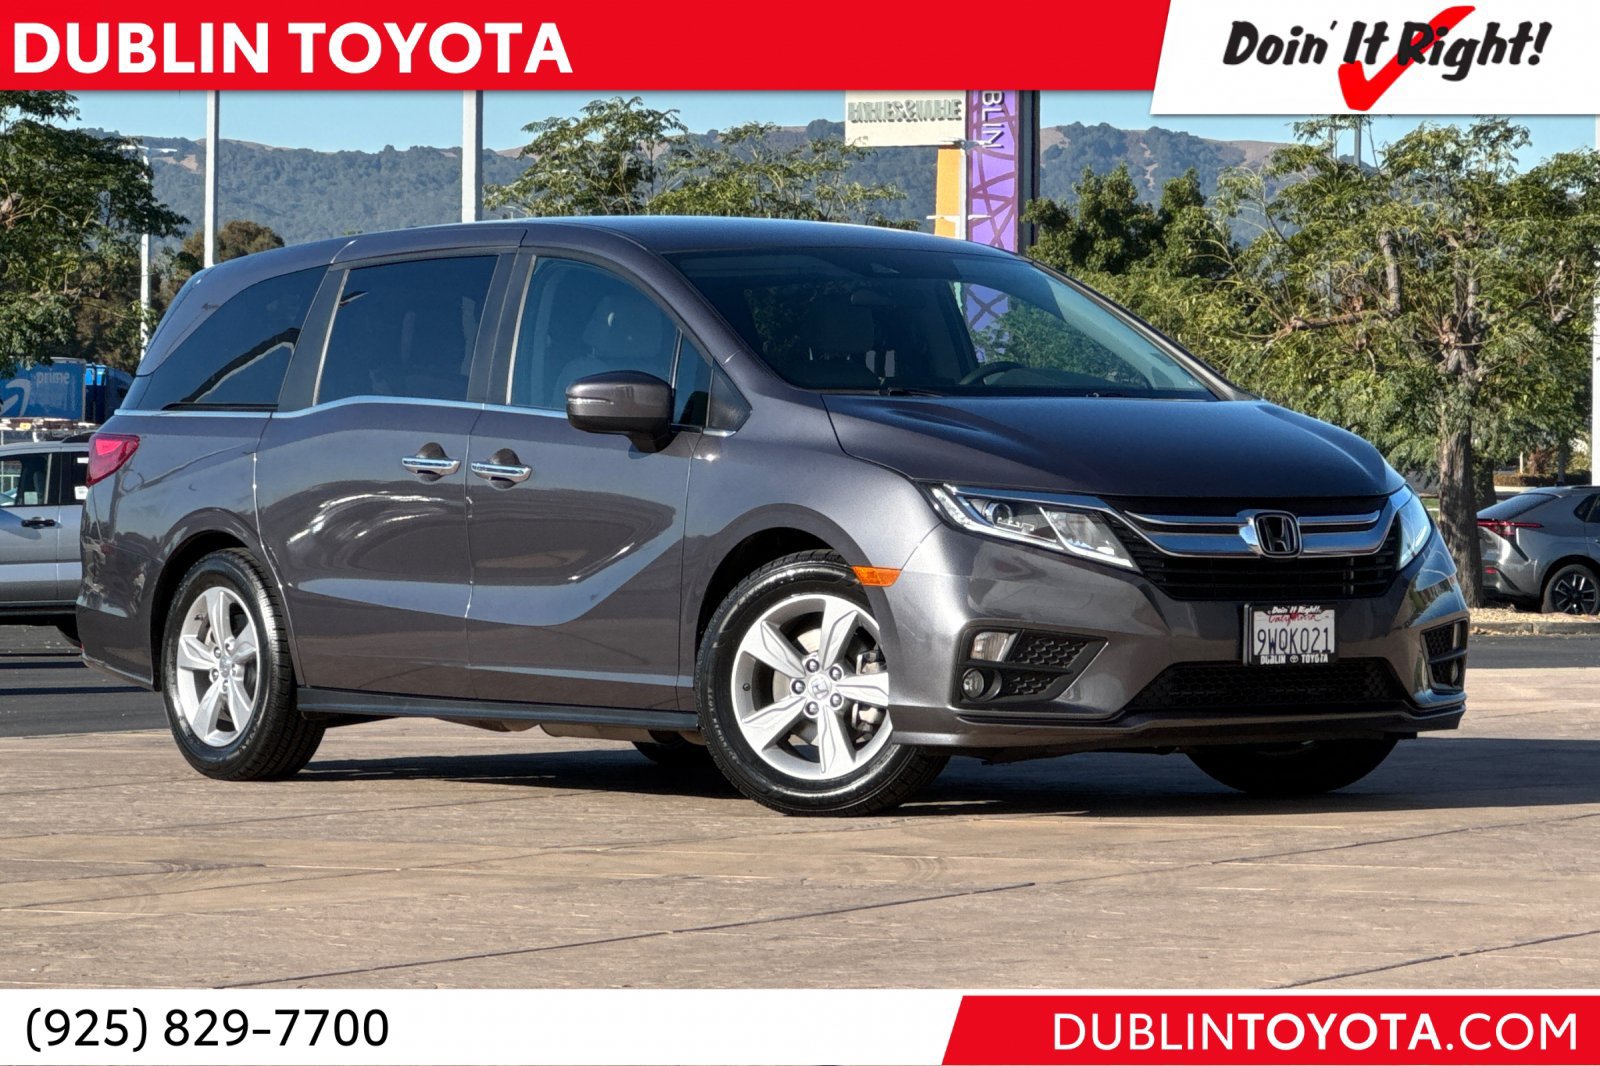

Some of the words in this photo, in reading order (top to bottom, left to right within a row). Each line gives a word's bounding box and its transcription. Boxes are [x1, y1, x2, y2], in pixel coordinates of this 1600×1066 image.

[35, 368, 70, 386] prime
[1257, 627, 1331, 655] 9WQK021
[1260, 654, 1286, 665] DUBLIN
[1301, 653, 1329, 664] TOYOTA
